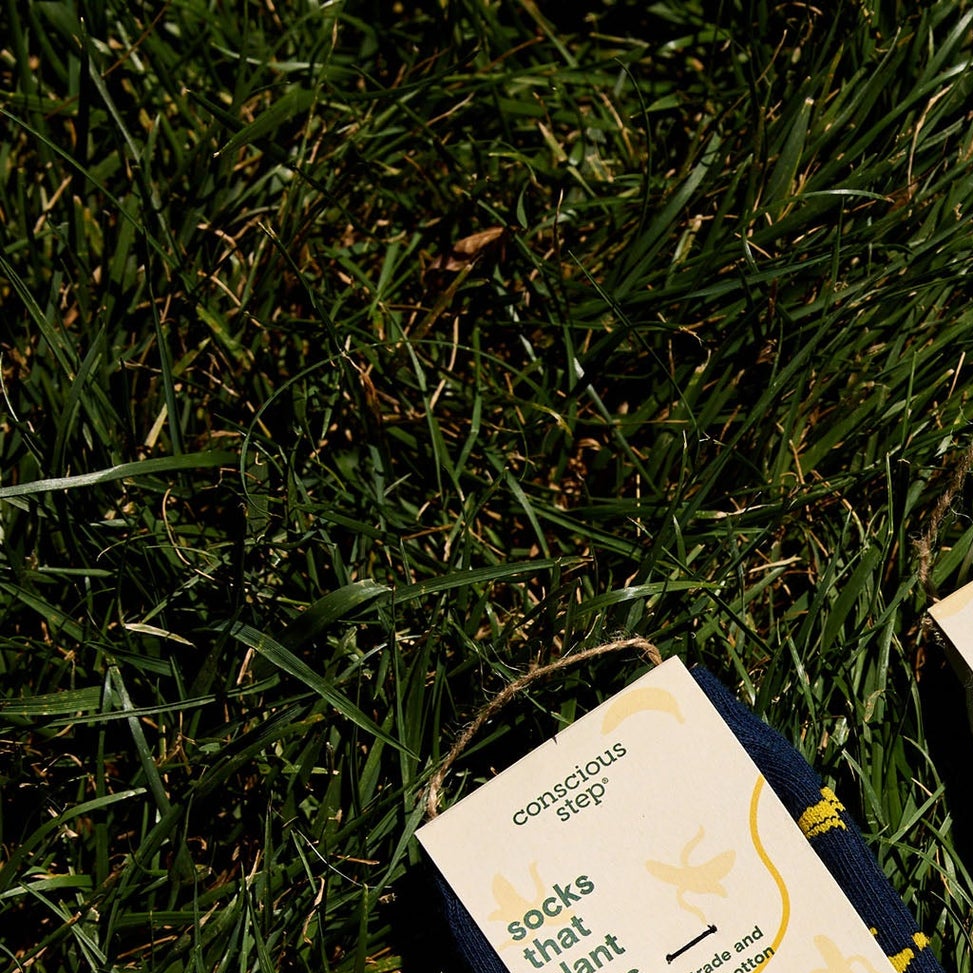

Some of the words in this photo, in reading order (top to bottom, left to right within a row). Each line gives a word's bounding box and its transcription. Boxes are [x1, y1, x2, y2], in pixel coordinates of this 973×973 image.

[512, 742, 627, 826] conscious
[507, 875, 595, 941] socks
[523, 915, 593, 969] that
[734, 925, 764, 953] and
